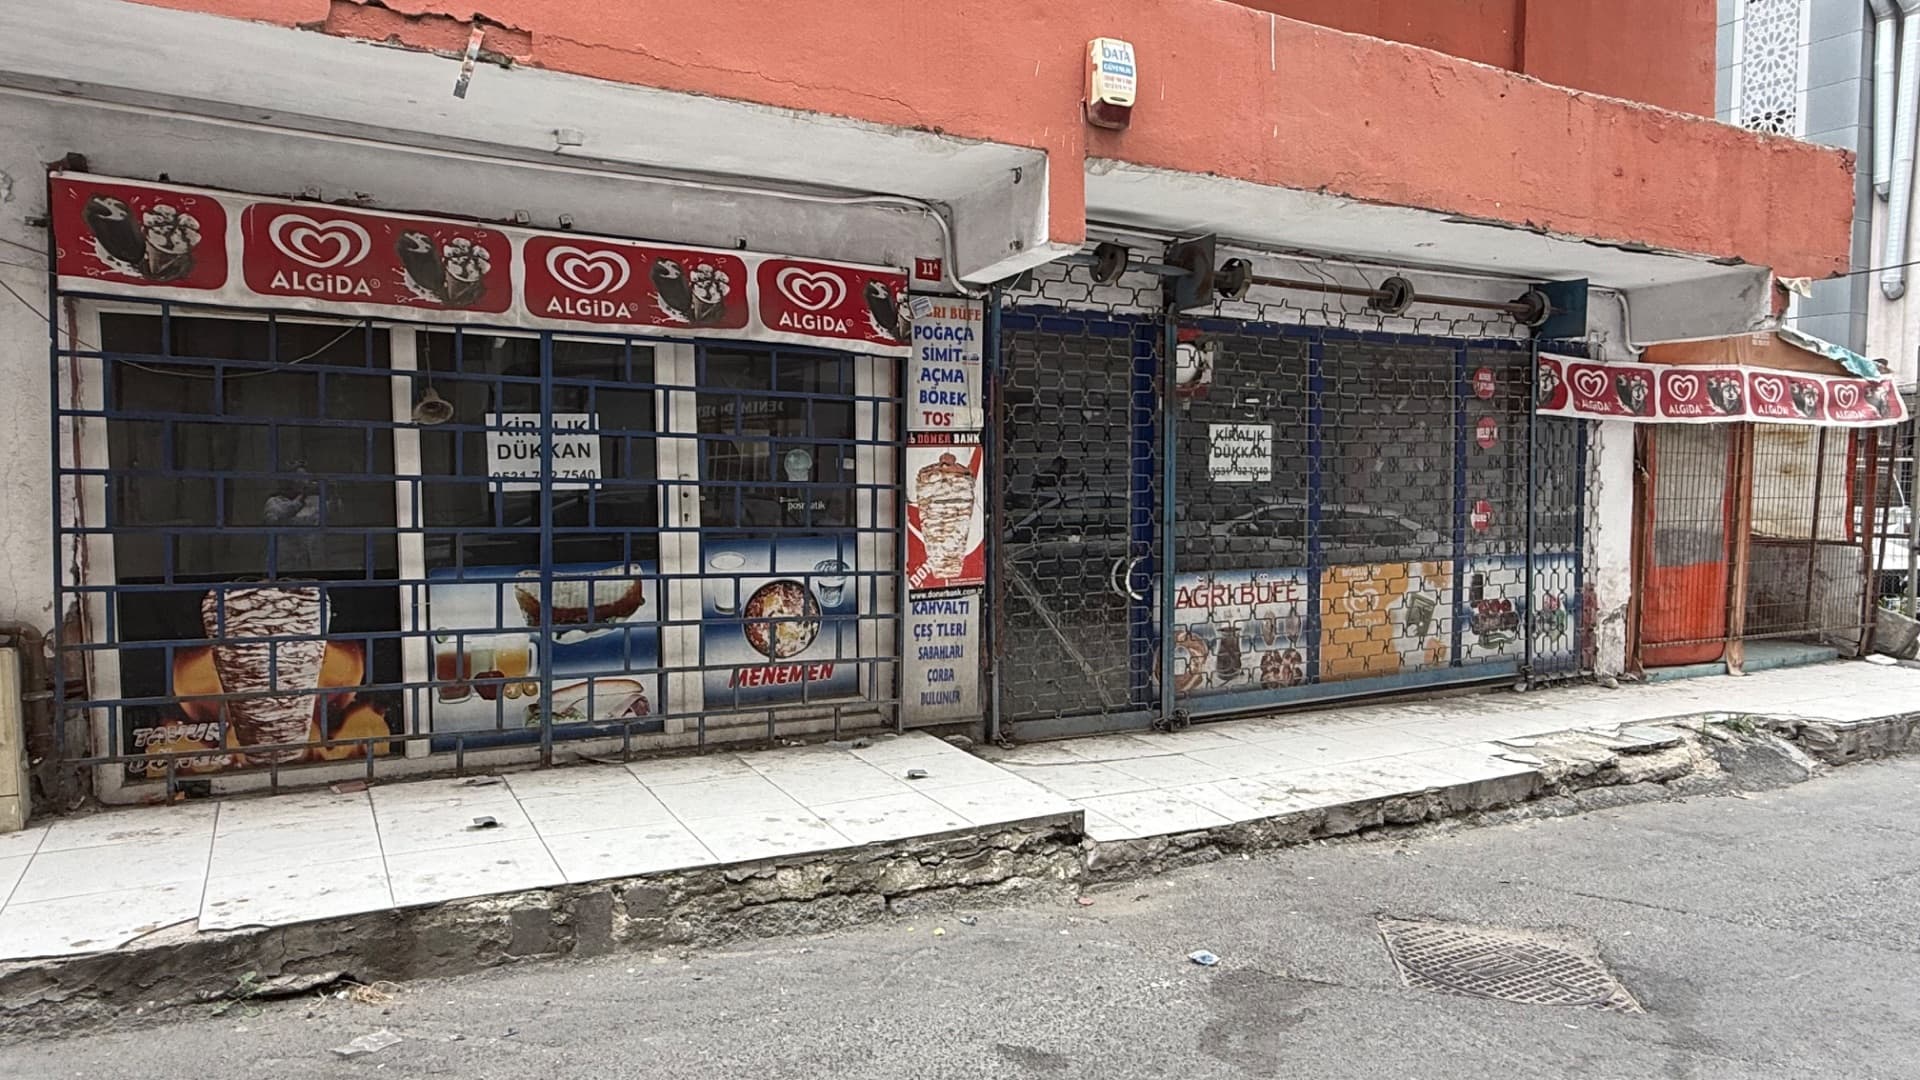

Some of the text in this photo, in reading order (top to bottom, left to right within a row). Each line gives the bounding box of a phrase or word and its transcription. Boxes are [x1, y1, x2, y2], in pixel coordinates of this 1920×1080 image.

[1103, 47, 1131, 63] DATA
[950, 304, 981, 321] BÜFE
[914, 321, 974, 346] POĞAÇA
[921, 342, 963, 363] SİMİT
[921, 367, 965, 387] AÇMA
[919, 386, 967, 405] BÖREK
[498, 416, 588, 437] KİRLIK
[922, 411, 954, 427] TOS
[953, 432, 981, 444] BANK
[1215, 427, 1265, 441] KİRALIK
[1214, 444, 1266, 458] DÜKKAN
[1239, 573, 1300, 605] BÜFE
[911, 601, 969, 616] KAHVALTI
[913, 620, 966, 642] ÇEŞTLERİ
[918, 645, 963, 661] SABAHLARI
[728, 663, 835, 689] MENEMEN
[926, 667, 955, 687] ÇORBA
[920, 690, 960, 706] BULUNUR
